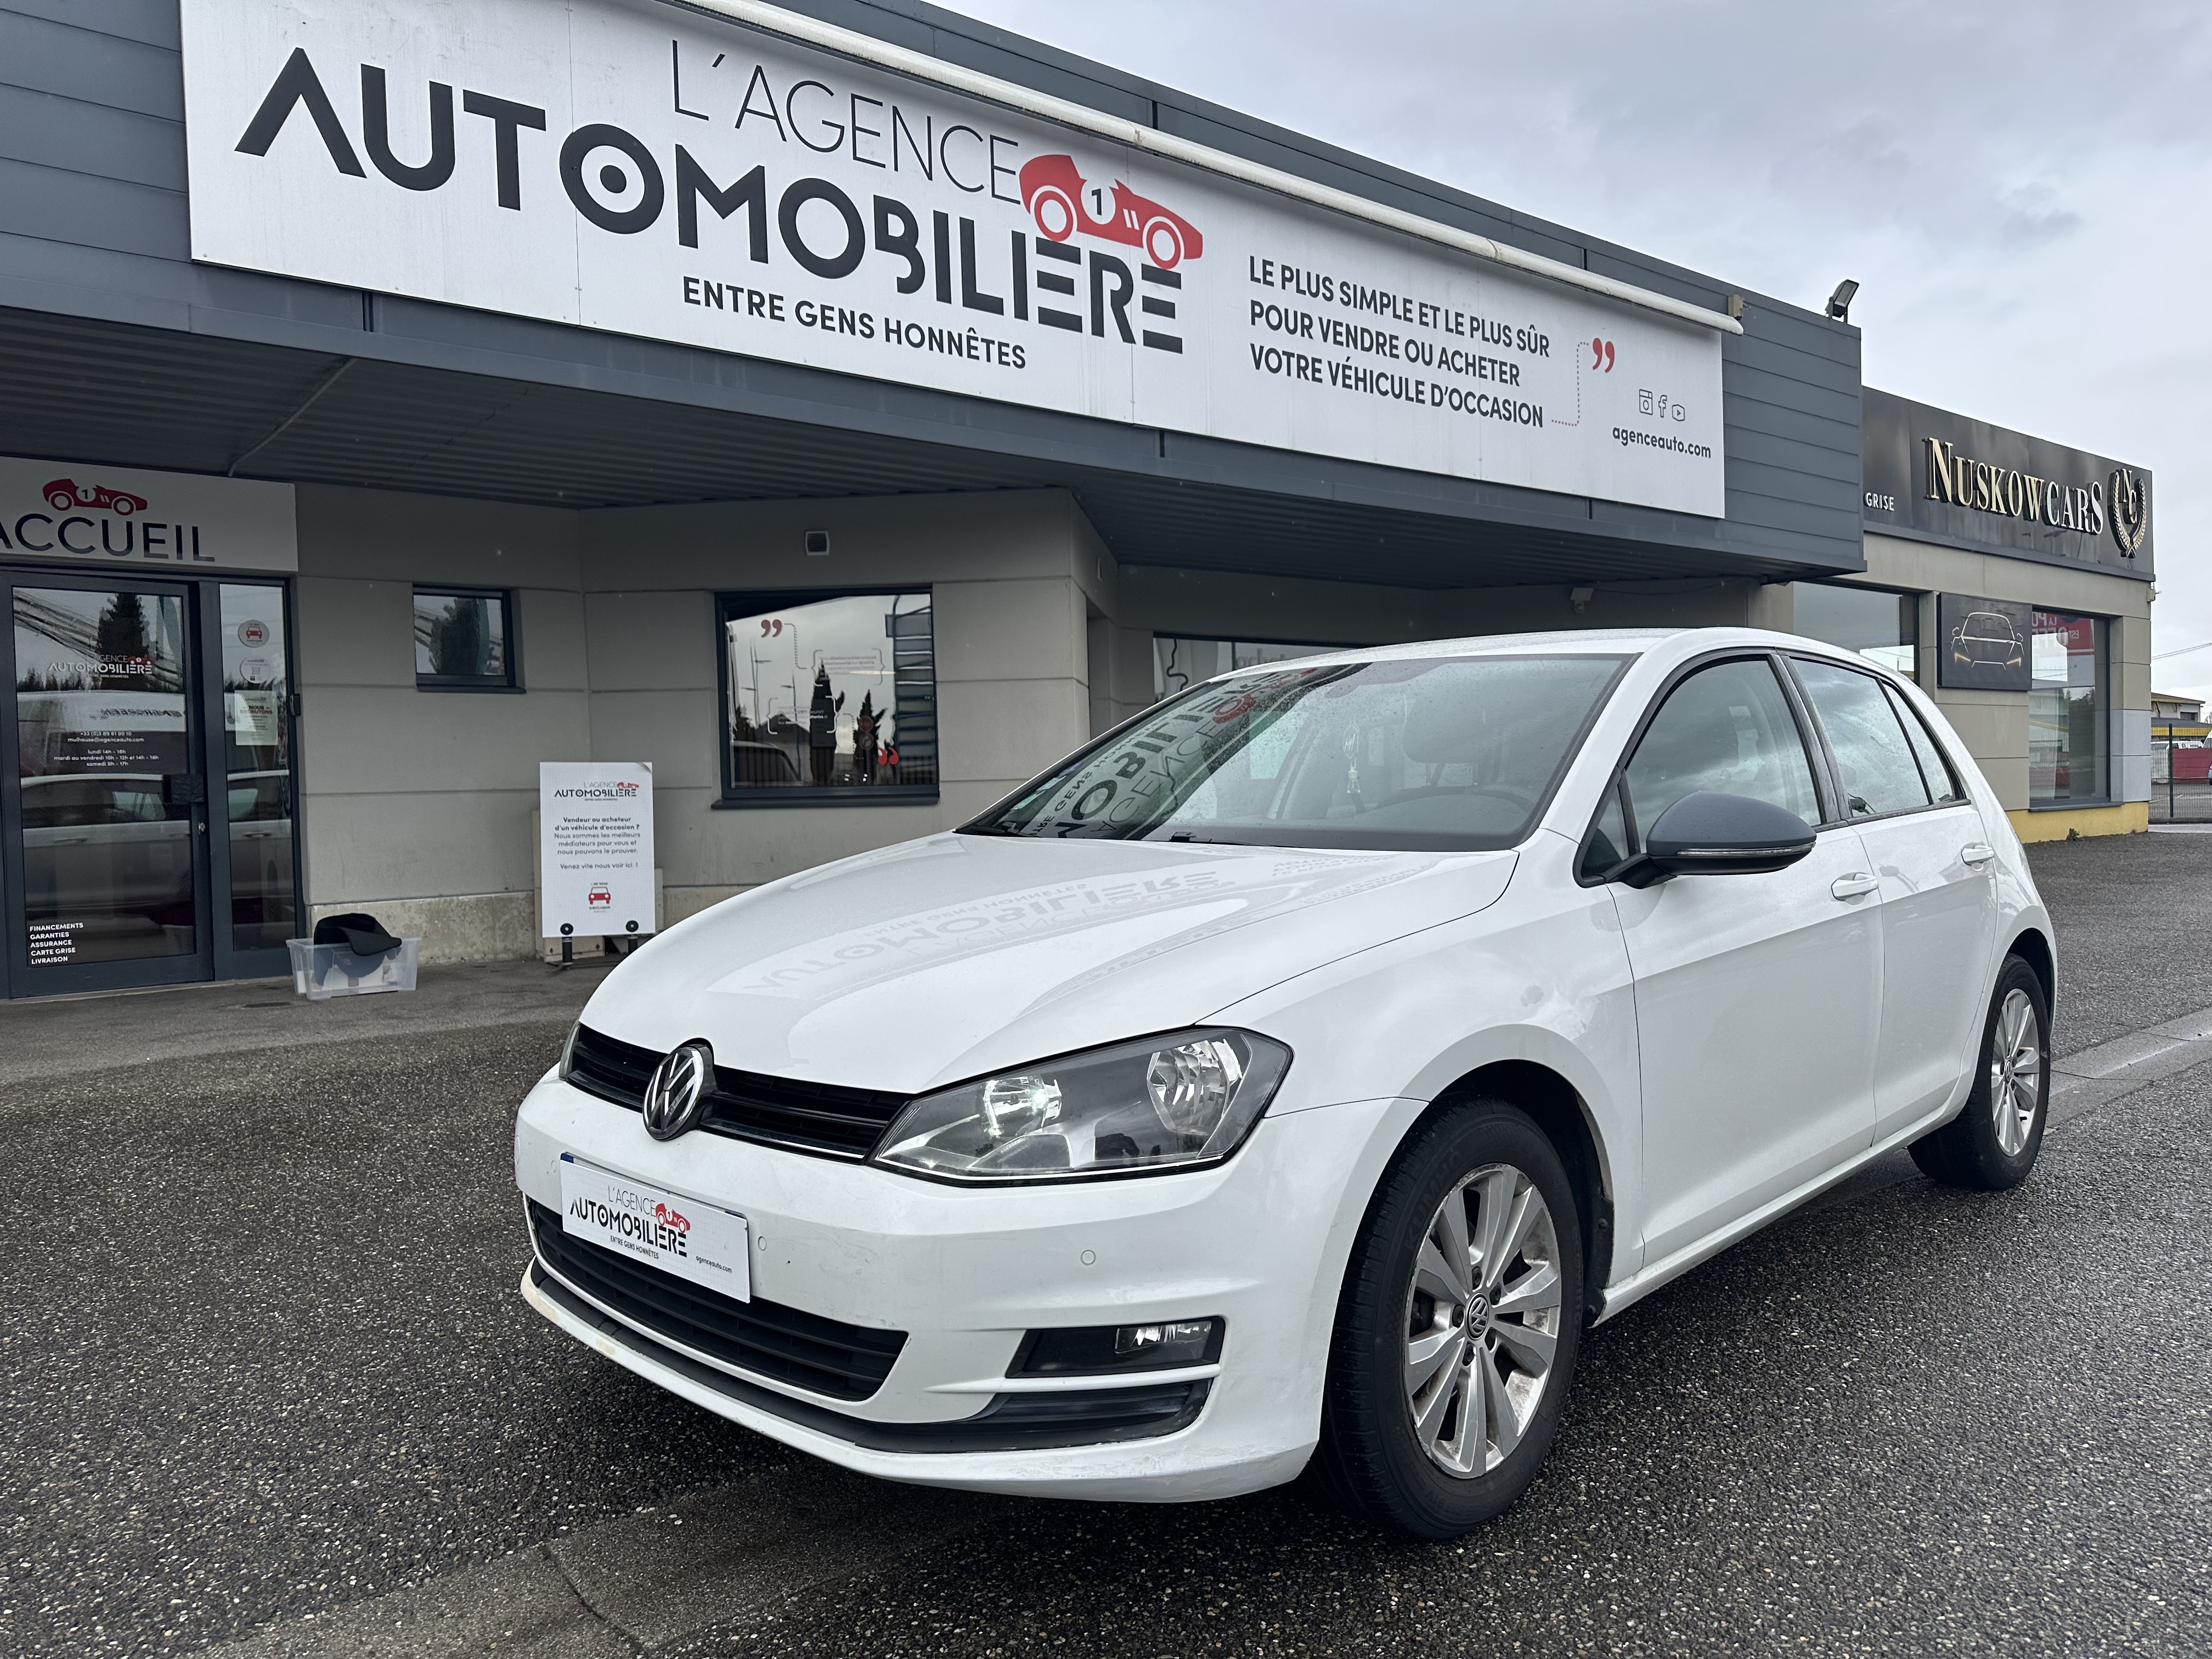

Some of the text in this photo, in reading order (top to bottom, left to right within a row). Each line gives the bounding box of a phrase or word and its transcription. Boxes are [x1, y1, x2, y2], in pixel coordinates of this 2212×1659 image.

[673, 39, 1021, 205] L'AGENCE
[1250, 255, 1550, 358] LE PLUS SIMPLE ET LE PLUS SÛR
[684, 276, 1026, 369] ENTRE GENS HONNÊTES
[1250, 299, 1520, 387] POUR VENDRE OU ACHETER
[1250, 343, 1543, 428] VOTRE VÉHICULE D'OCCASION
[1612, 427, 1711, 459] agenceauto.com
[1865, 492, 1895, 512] GRISE
[30, 922, 84, 932] FINANCEMENTS
[30, 932, 70, 940] GARANTIES
[30, 939, 72, 948] ASSURANCE
[31, 956, 68, 964] LIVRAISON
[608, 1185, 656, 1217] L'AGENCE
[610, 1235, 659, 1260] ENTRE GENS HONNÊTES
[696, 1255, 732, 1273] agenceauto.com
